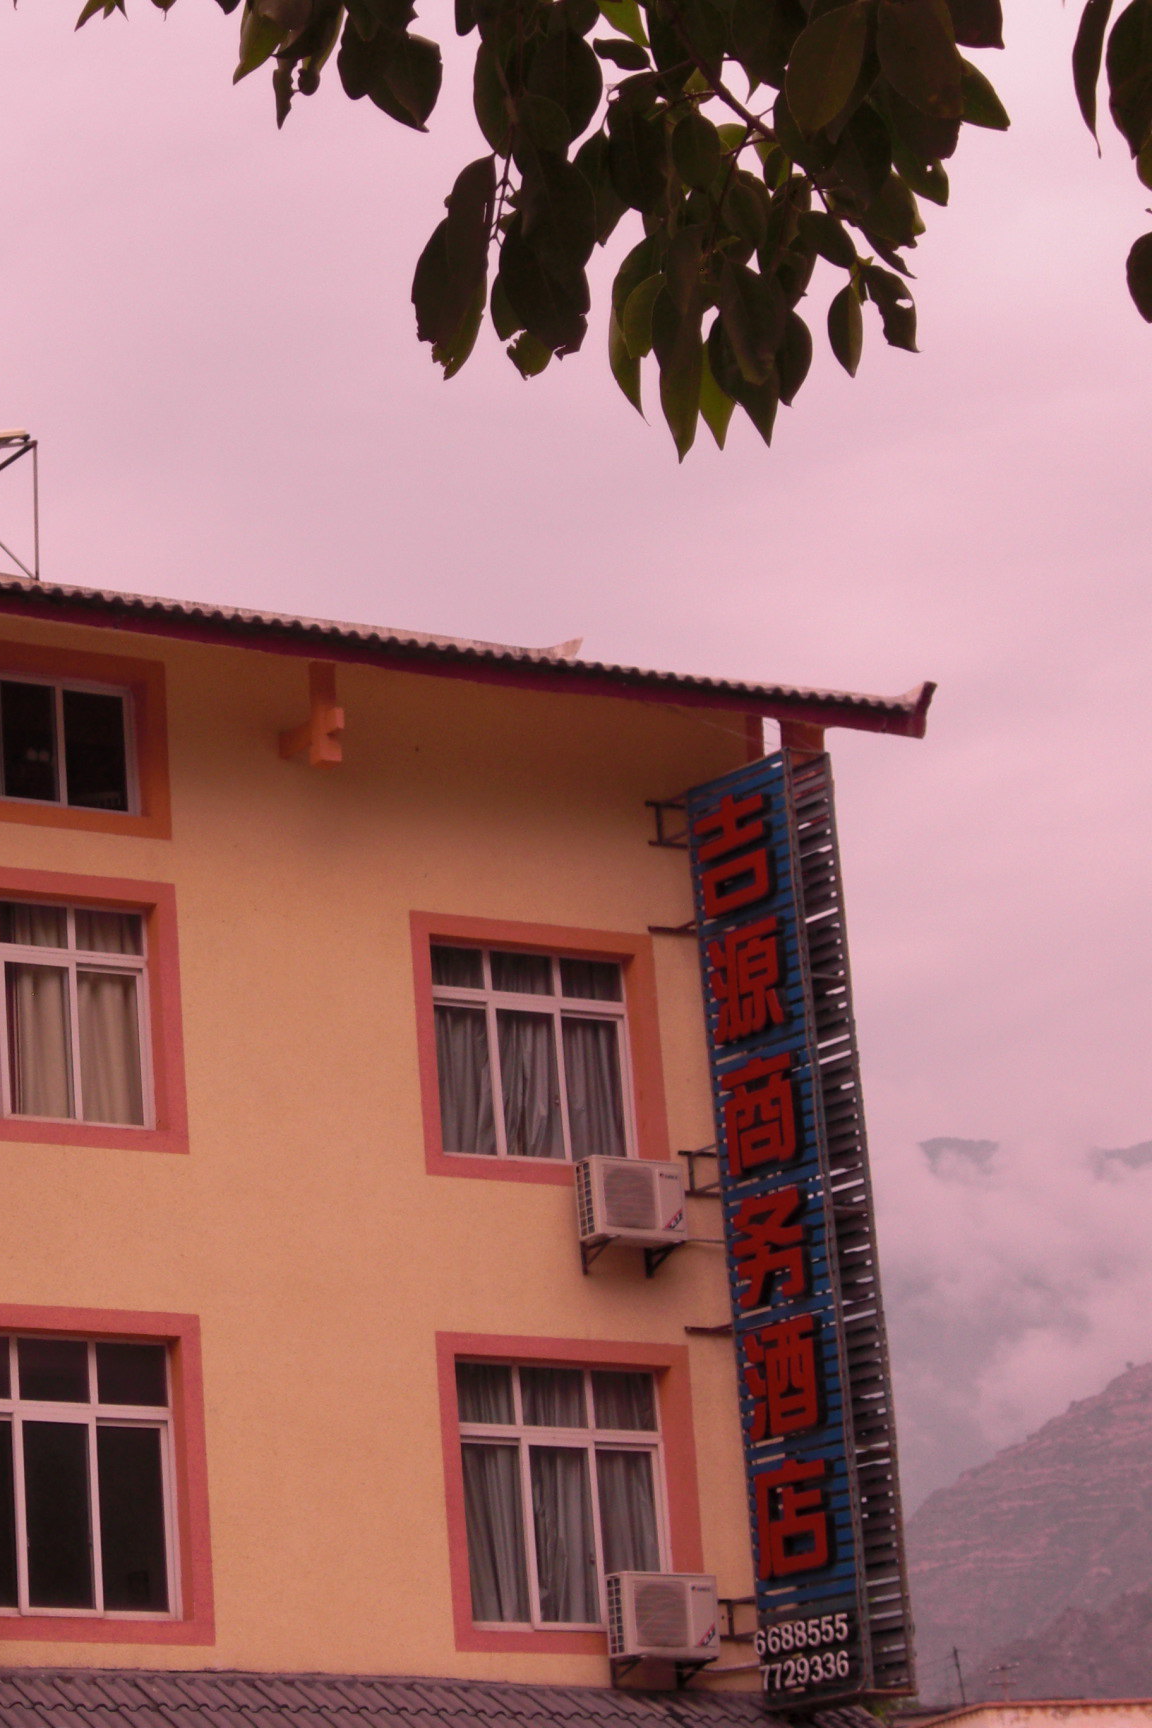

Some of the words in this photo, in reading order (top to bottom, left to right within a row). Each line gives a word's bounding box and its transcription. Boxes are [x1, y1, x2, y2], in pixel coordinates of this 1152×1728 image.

[693, 793, 830, 1581] 吉源商务酒店
[754, 1612, 849, 1657] 6688555
[759, 1649, 850, 1691] 7729336
